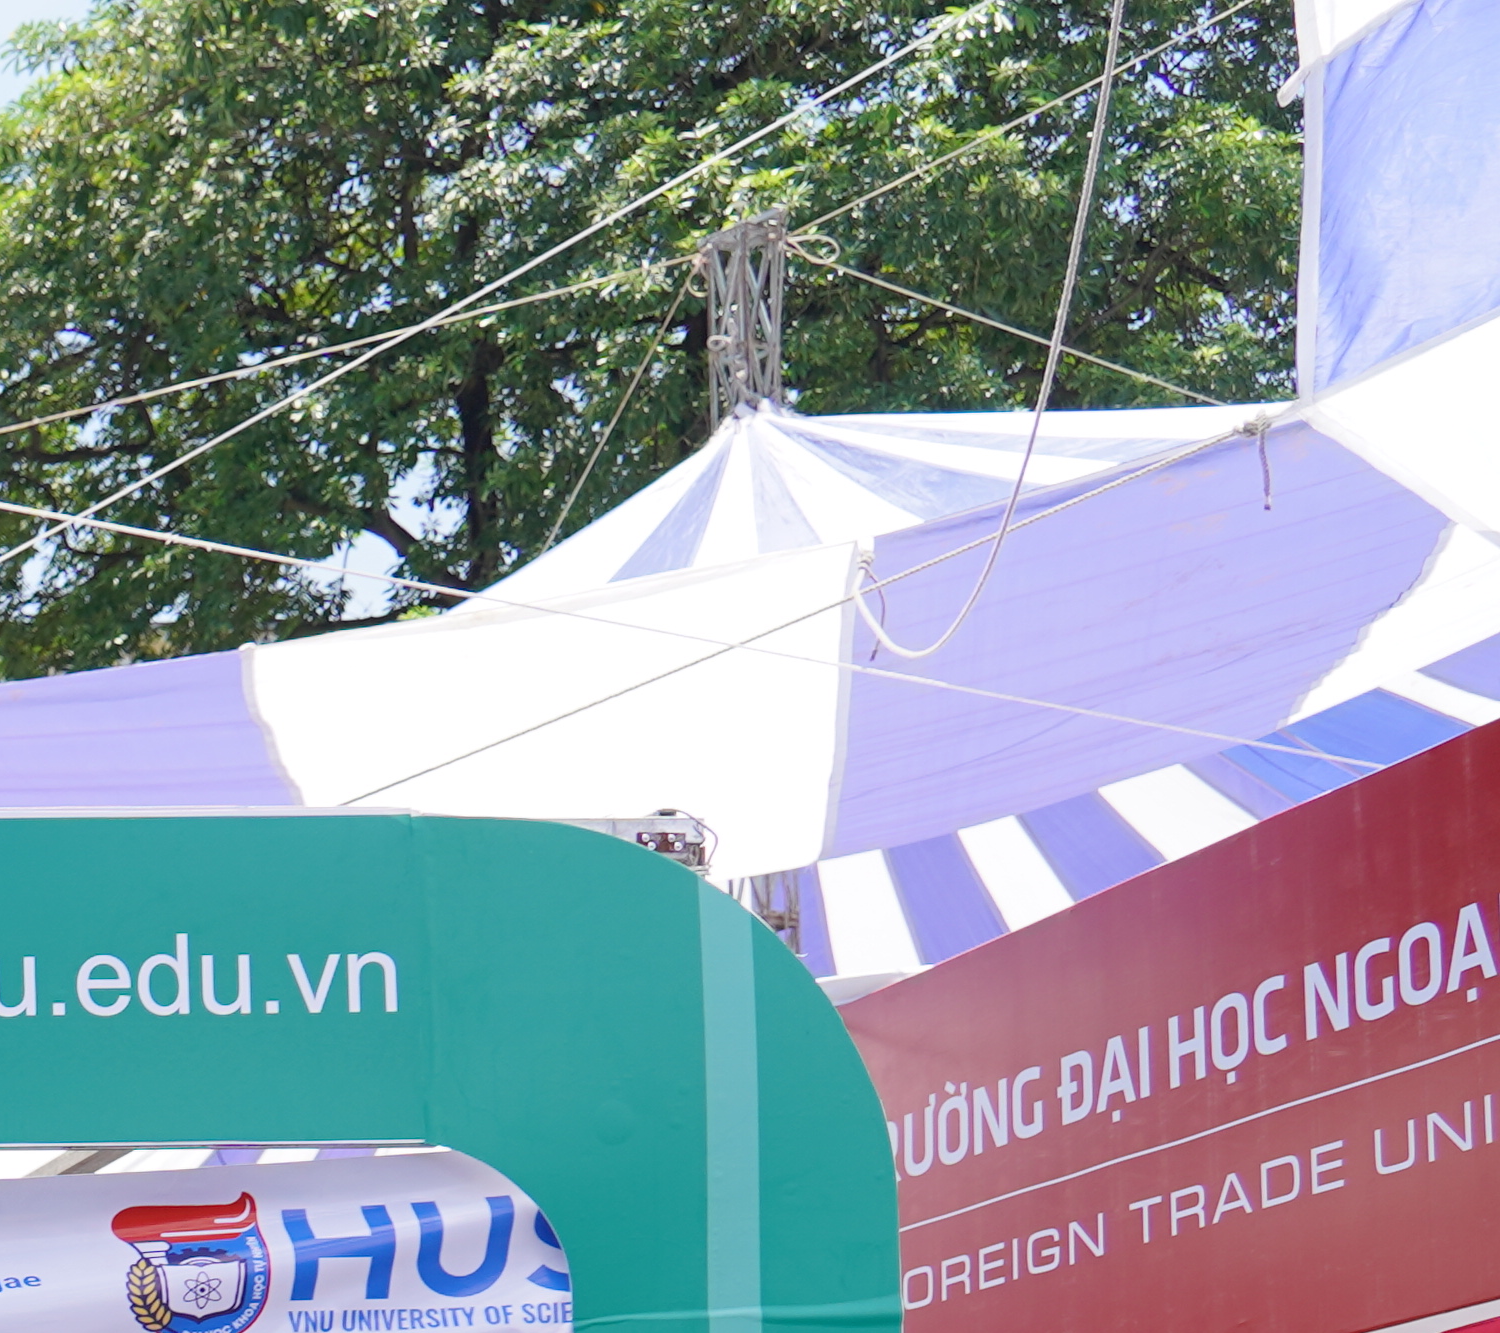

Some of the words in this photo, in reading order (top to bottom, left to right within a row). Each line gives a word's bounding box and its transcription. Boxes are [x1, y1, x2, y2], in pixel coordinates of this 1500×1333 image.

[1057, 1026, 1151, 1124] ĐẠI
[1168, 974, 1287, 1085] HỌC
[1304, 902, 1499, 1043] NGOẠ
[902, 1212, 1106, 1311] OREIGN
[1129, 1140, 1345, 1245] TRADE
[1373, 1093, 1495, 1176] UNI
[288, 1311, 334, 1333] VNU
[341, 1307, 475, 1332] UNIVERSITY
[484, 1304, 512, 1325] OF
[523, 1302, 572, 1324] SCIE
